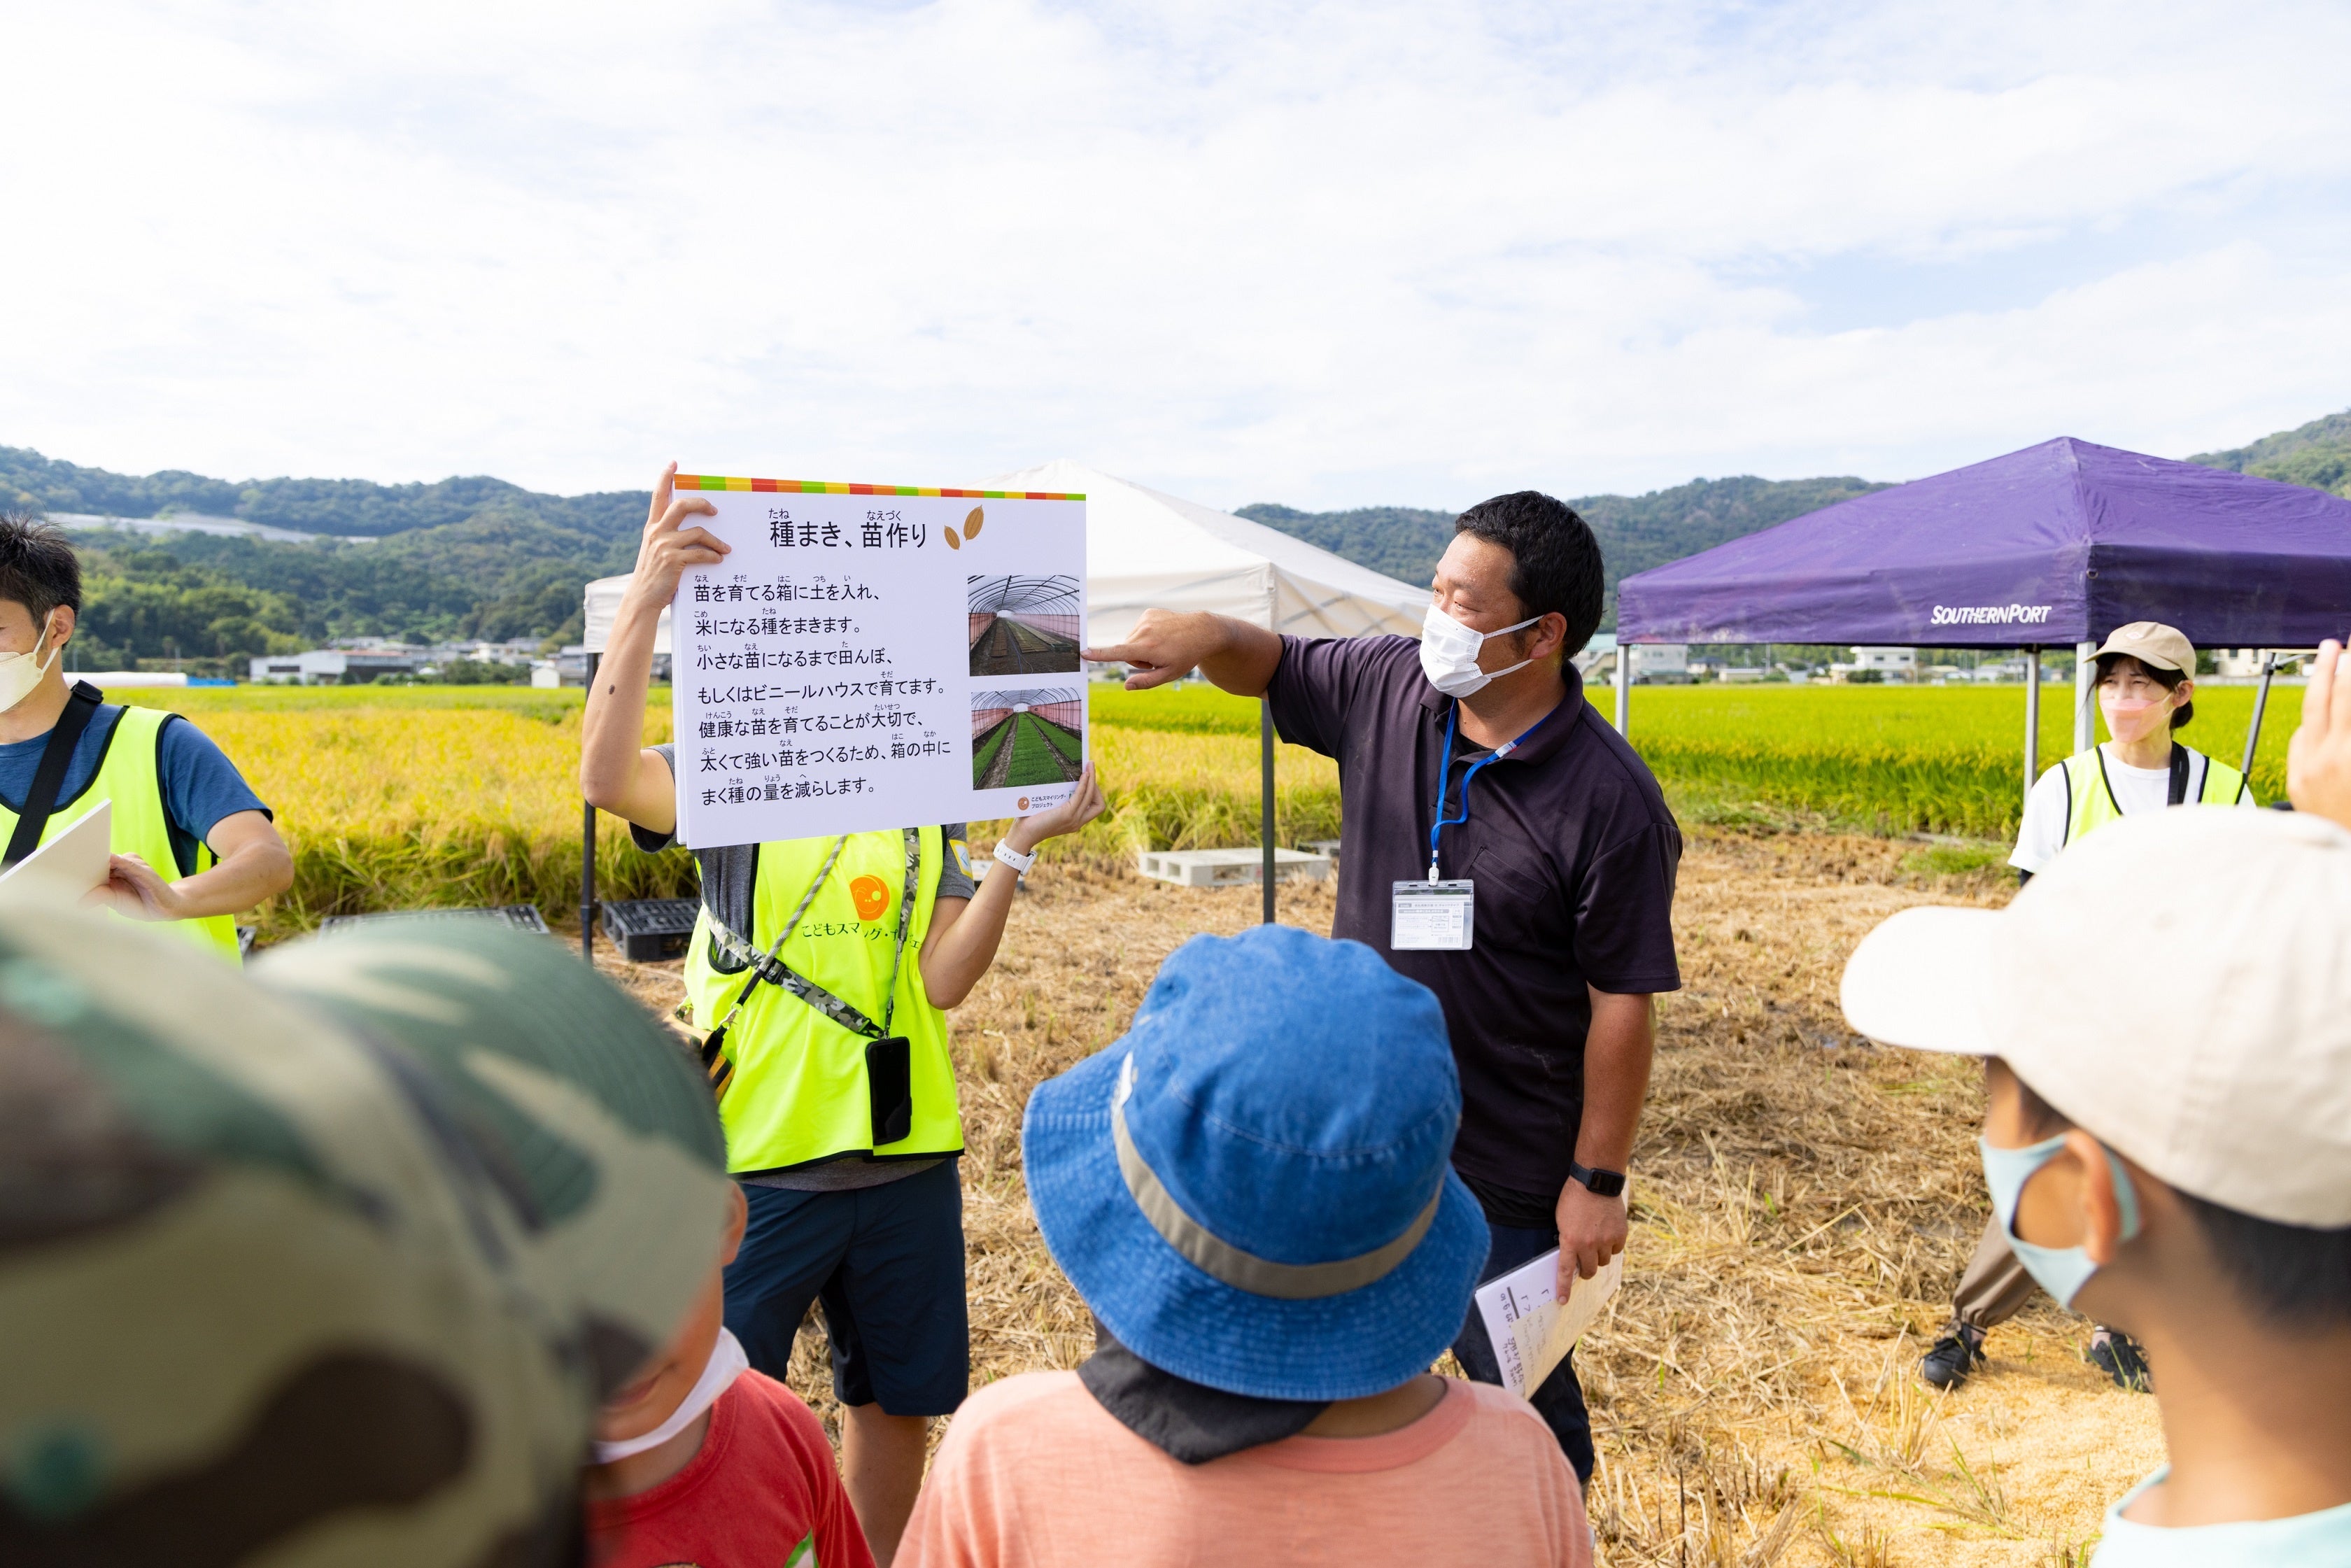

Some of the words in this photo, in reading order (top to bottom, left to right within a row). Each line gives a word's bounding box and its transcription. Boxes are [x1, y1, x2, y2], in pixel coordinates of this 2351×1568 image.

[768, 507, 790, 520] たね
[866, 509, 901, 521] なえづく
[770, 520, 926, 549] 種まき、苗作り
[694, 574, 709, 583] なえ
[733, 574, 747, 583] そだ
[812, 574, 826, 583] つち
[693, 583, 880, 602] 苗を育てる箱に土を入れ、
[762, 607, 777, 615] たね
[695, 616, 860, 637] 米になる種をまきます。
[697, 644, 712, 652] ちい
[744, 643, 758, 651] なえ
[696, 647, 892, 670] 小さな苗になるまで田んぼ、
[880, 670, 894, 679] そだ
[698, 677, 944, 705] もしくはビニールハウスで育てます。
[751, 707, 765, 716] なえ
[784, 705, 798, 714] そだ
[705, 710, 732, 720] けんこう
[698, 711, 923, 739] 健康な苗を育てることが大切で、
[779, 739, 793, 747] なえ
[700, 740, 951, 772] 太くて強い苗をつくるため、箱の中に
[702, 747, 716, 756] ふと
[728, 777, 744, 785] たね
[764, 774, 781, 783] りょう
[701, 776, 874, 806] まく種の量を減らします。
